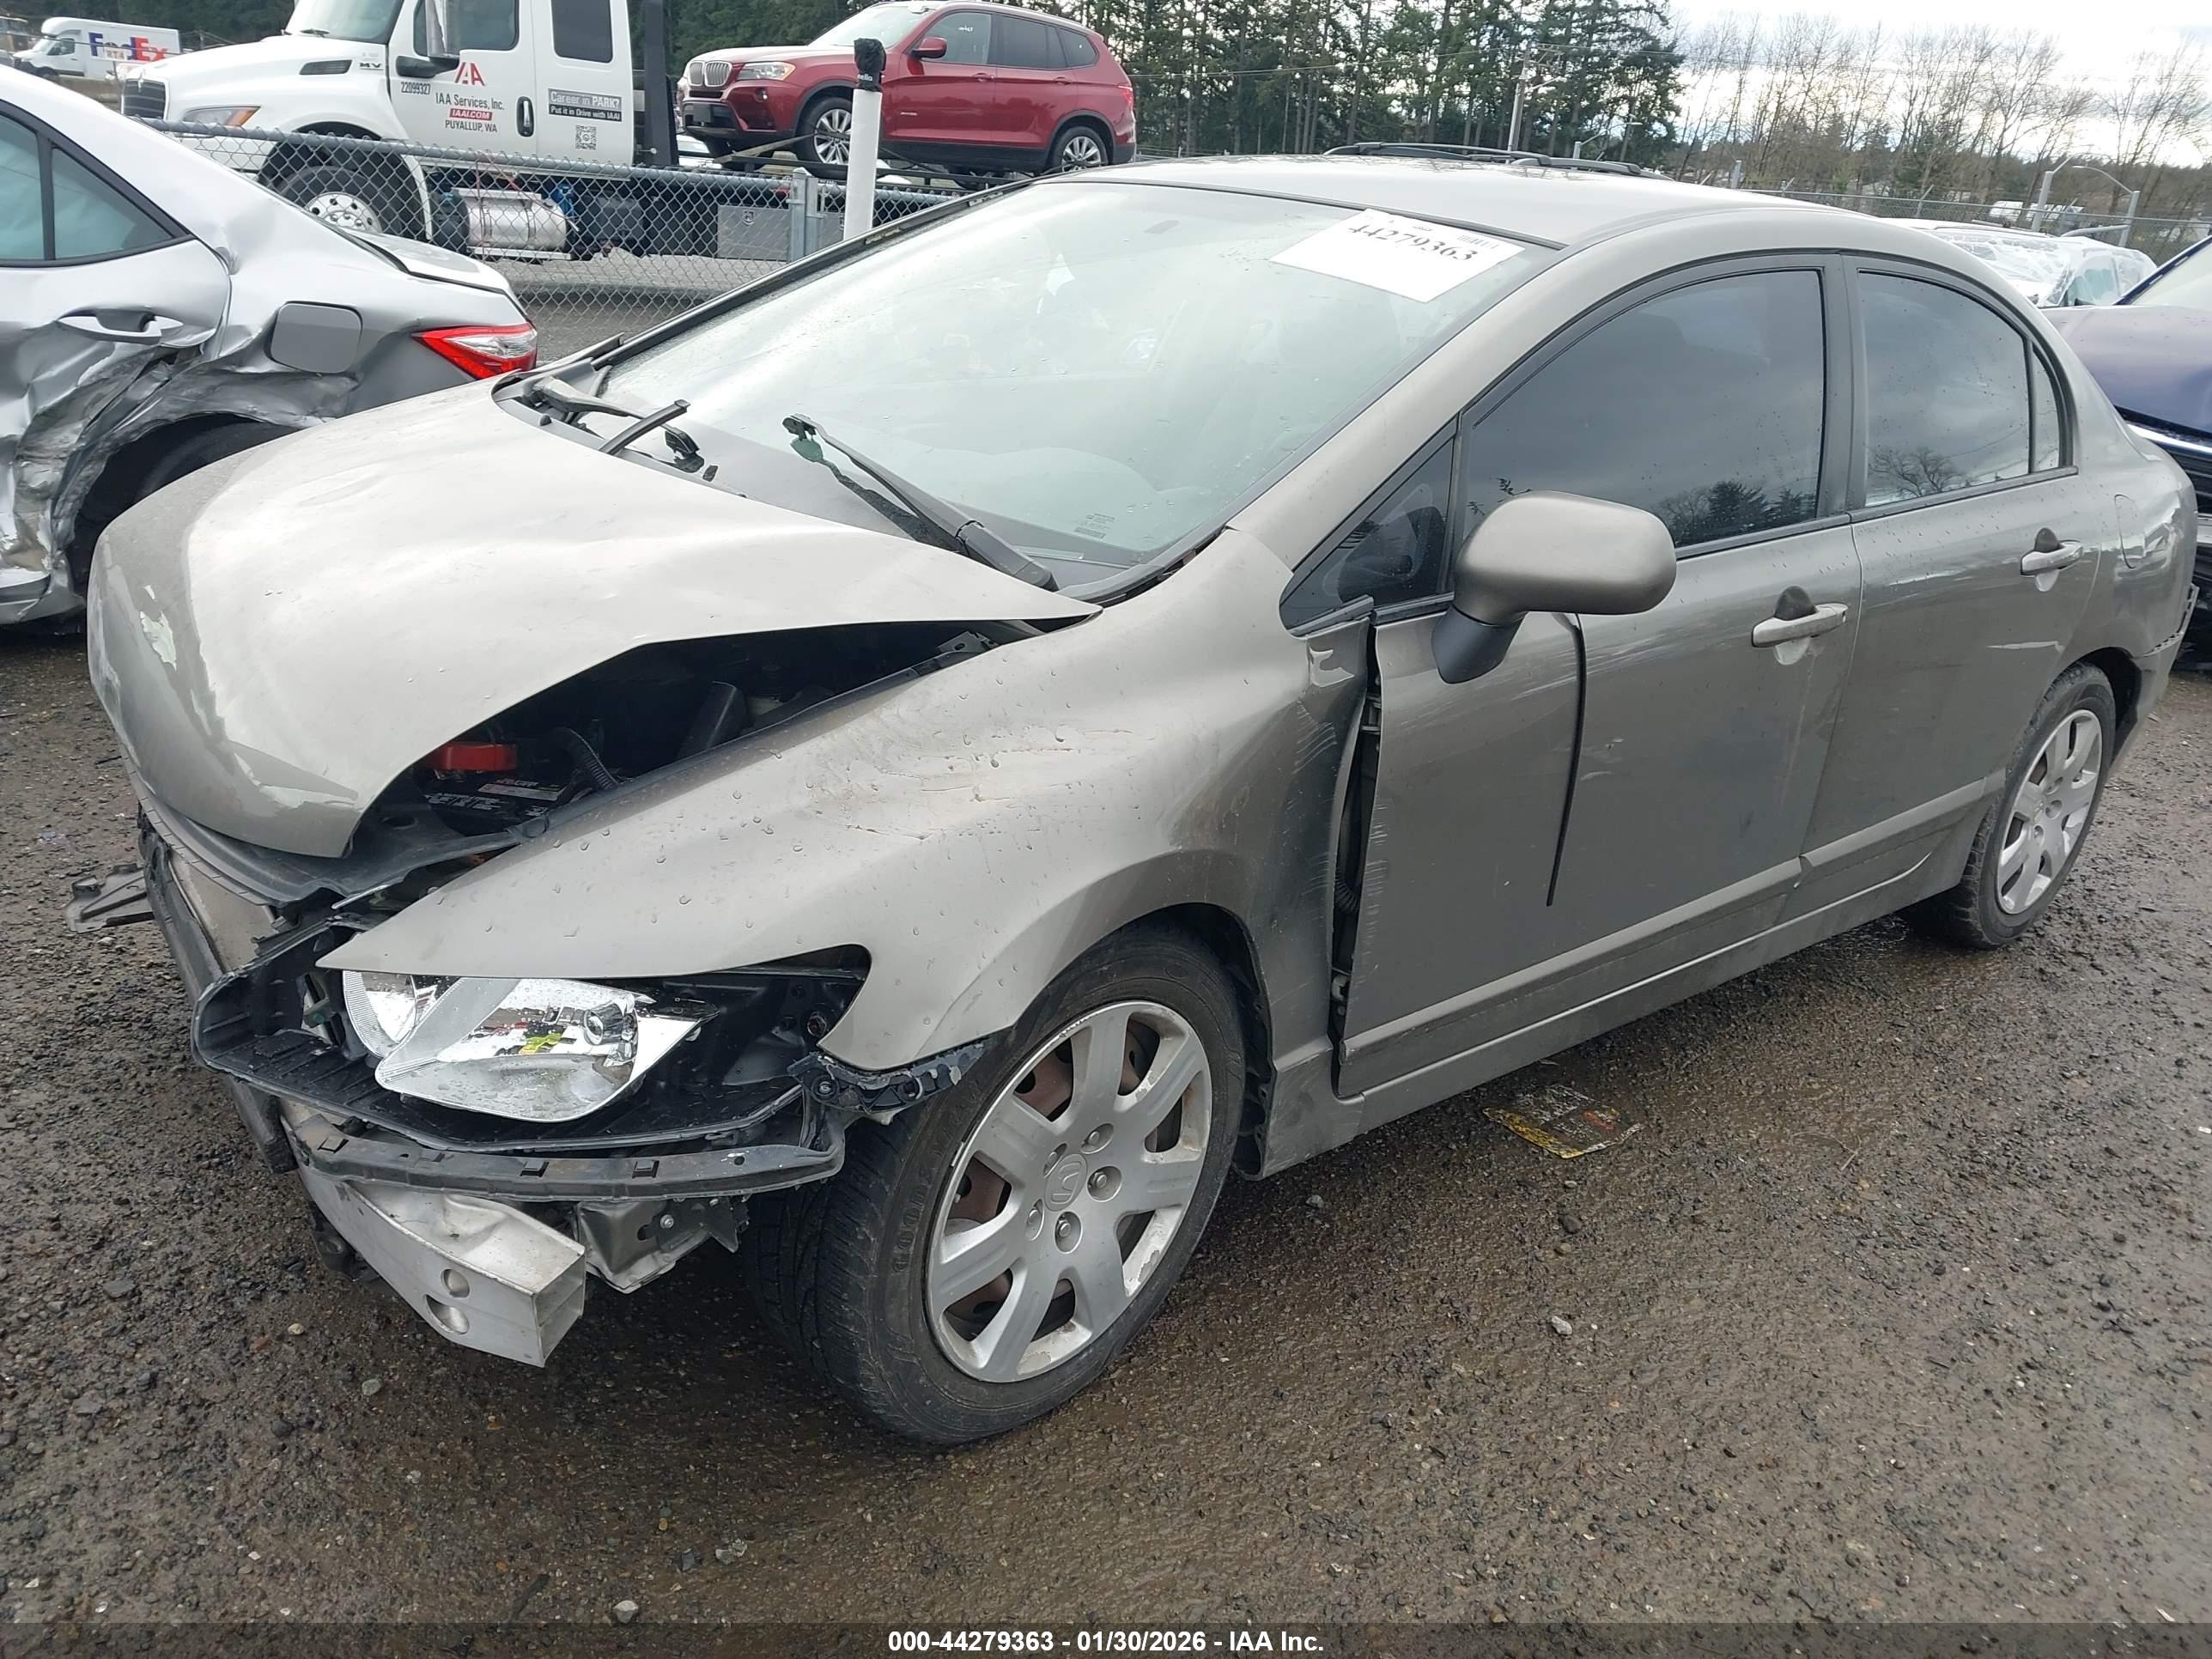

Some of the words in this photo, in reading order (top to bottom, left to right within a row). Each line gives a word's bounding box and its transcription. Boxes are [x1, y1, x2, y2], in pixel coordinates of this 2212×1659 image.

[400, 82, 431, 95] 22099327
[435, 93, 452, 105] IAA
[453, 94, 490, 110] Services,
[491, 98, 505, 110] Inc.
[550, 91, 580, 104] Career
[582, 97, 590, 106] in
[592, 96, 619, 109] PARK?
[452, 109, 489, 119] IAAI.COM
[550, 106, 562, 114] Put
[575, 108, 591, 118] Drive
[445, 119, 483, 132] PUYALLUP,
[484, 124, 497, 132] WA
[1348, 224, 1479, 261] 44279363
